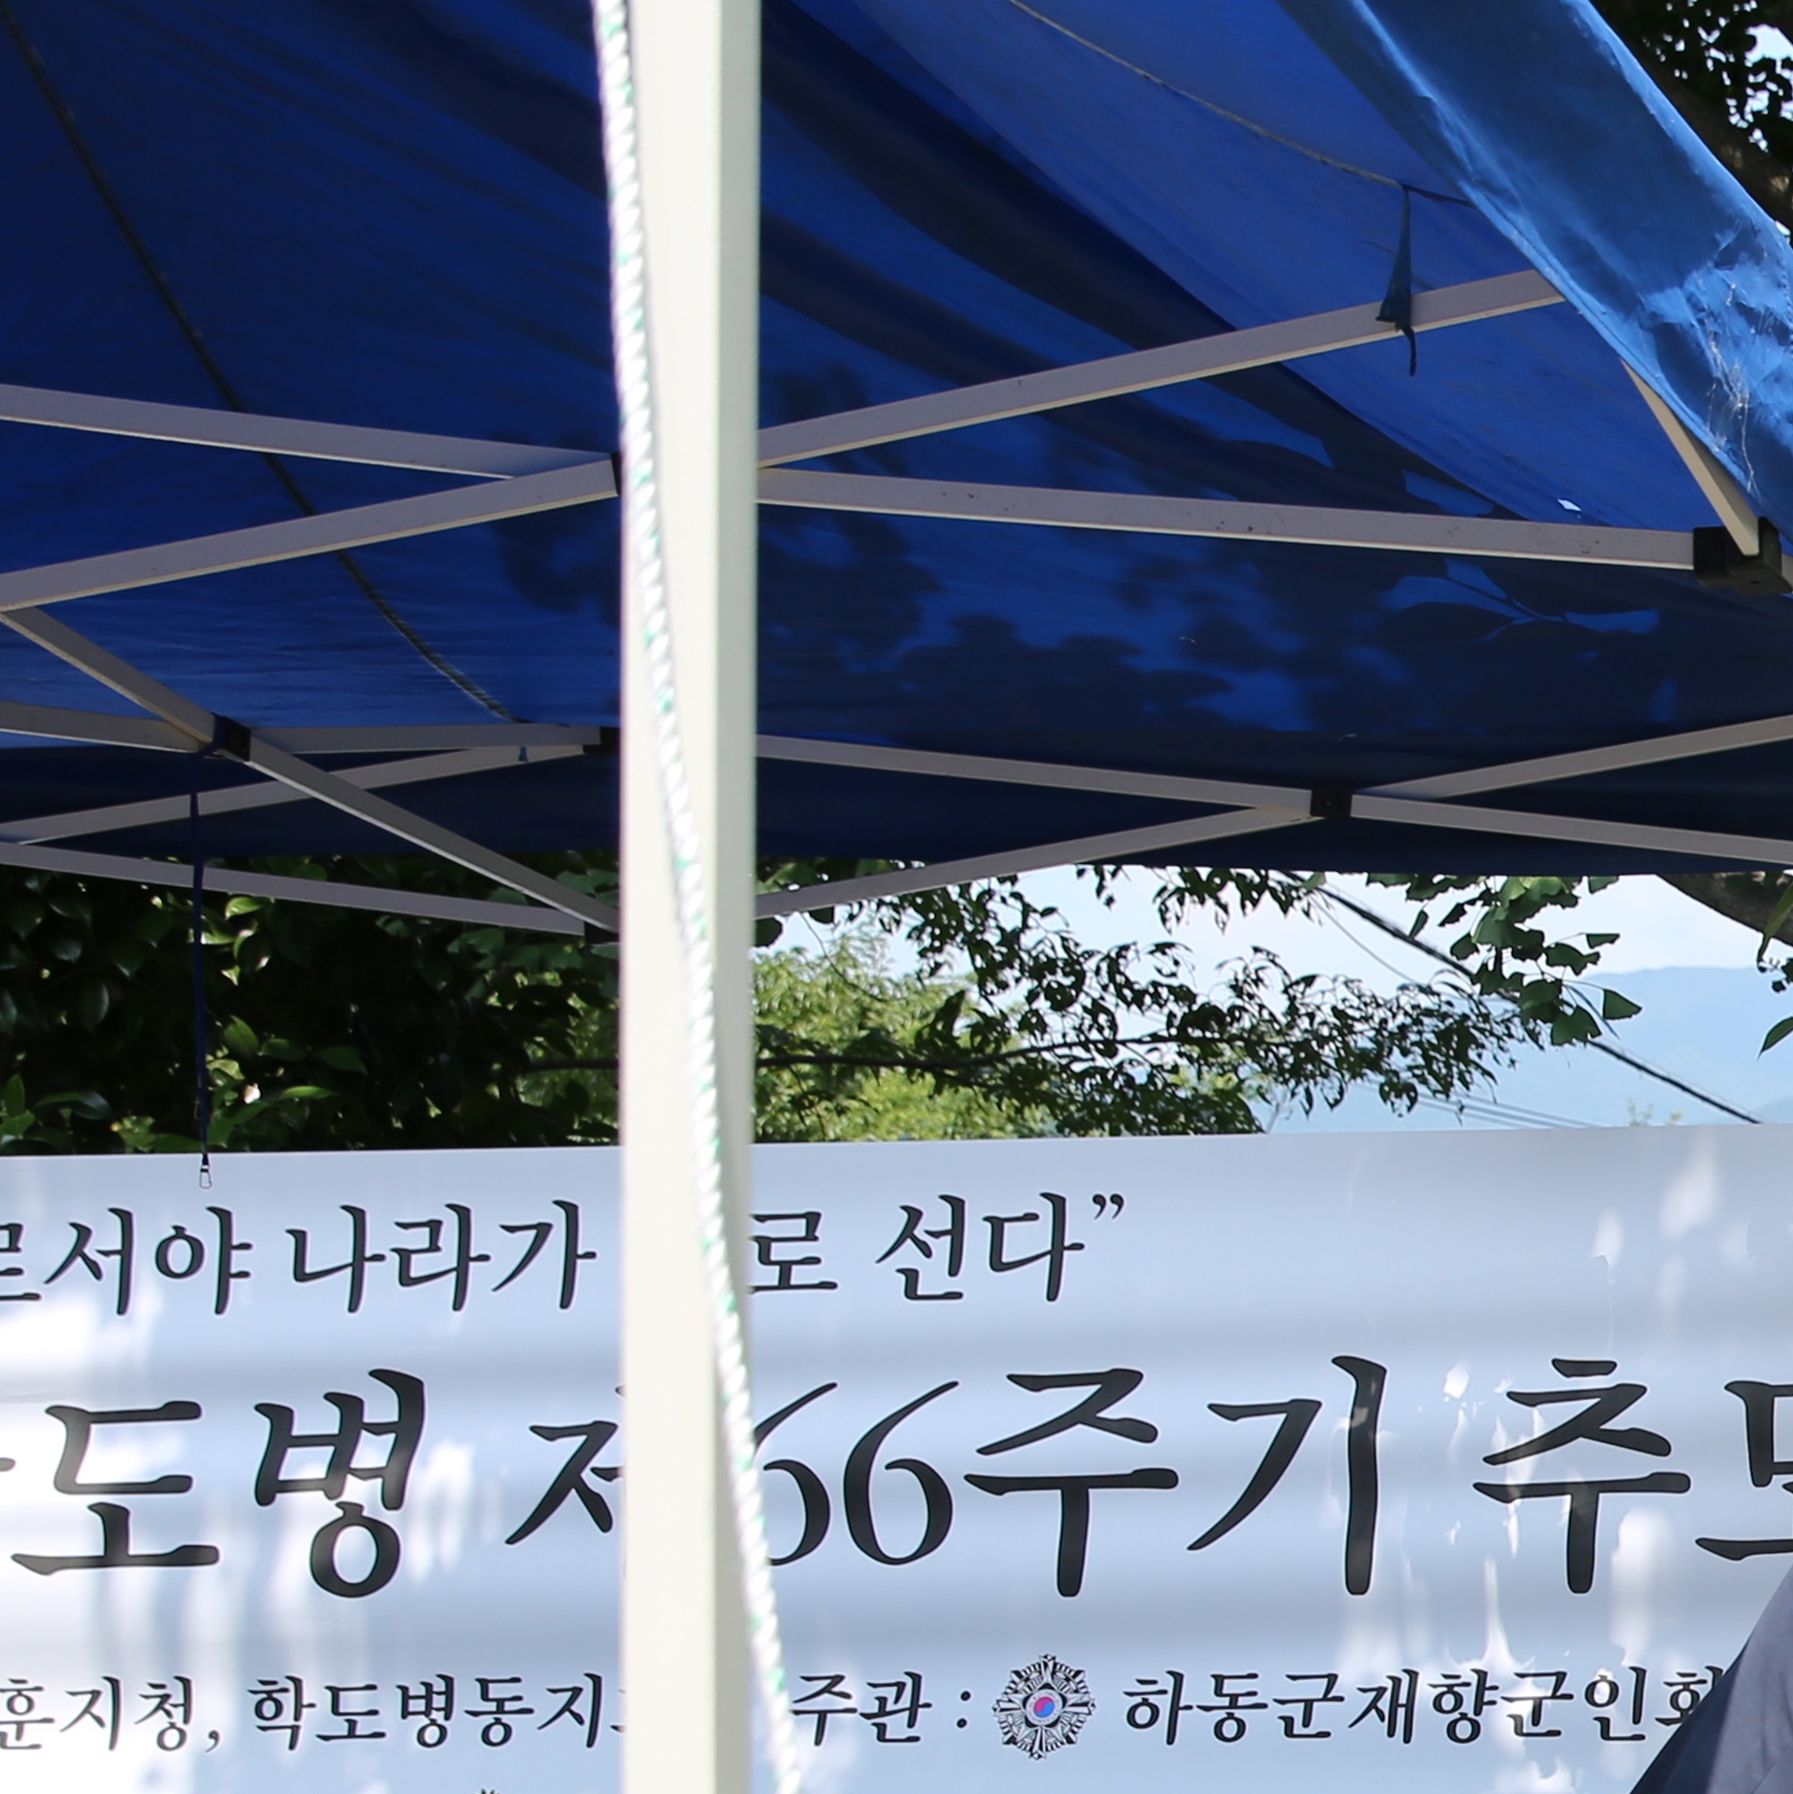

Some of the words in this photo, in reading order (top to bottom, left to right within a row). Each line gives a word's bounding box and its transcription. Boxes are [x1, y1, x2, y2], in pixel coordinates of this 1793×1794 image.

[286, 1200, 597, 1313] 나라가
[877, 1193, 1125, 1302] 선다”
[0, 1368, 425, 1598] 도병
[0, 1675, 220, 1752] 훈지청,
[247, 1672, 626, 1752] 학도병동지
[791, 1671, 932, 1746] 주관
[1123, 1666, 1723, 1746] 하동군재향군인회
